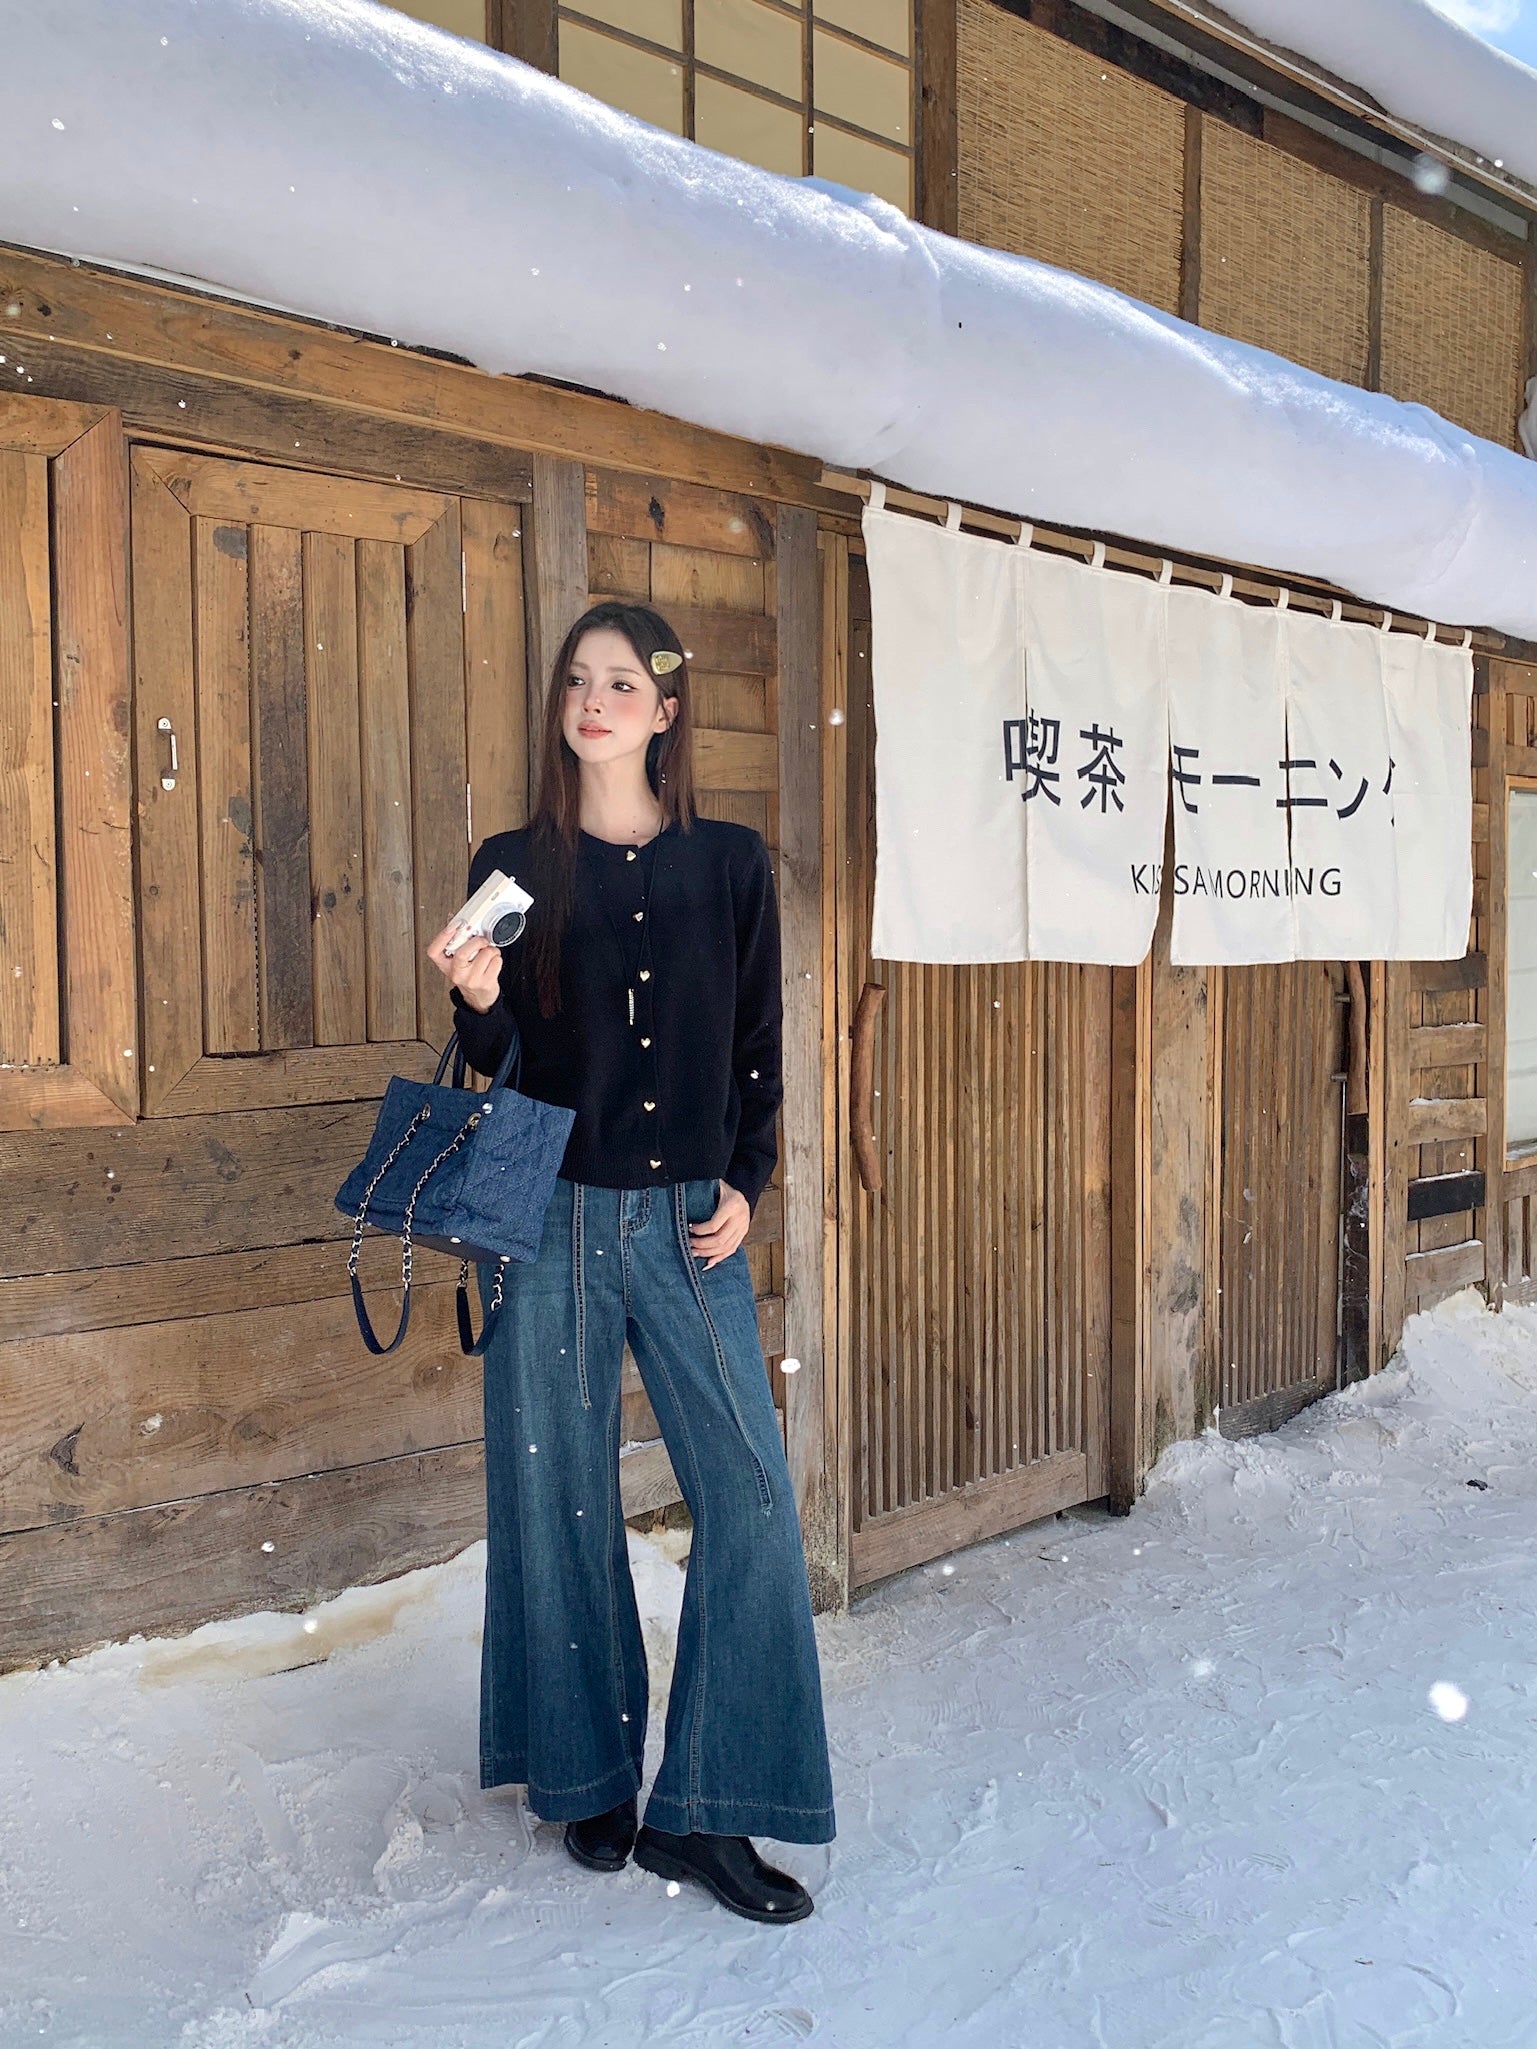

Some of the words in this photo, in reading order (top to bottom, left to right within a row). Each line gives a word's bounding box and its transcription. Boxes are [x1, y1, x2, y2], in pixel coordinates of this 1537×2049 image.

[1003, 708, 1396, 827] 喫茶モーニン
